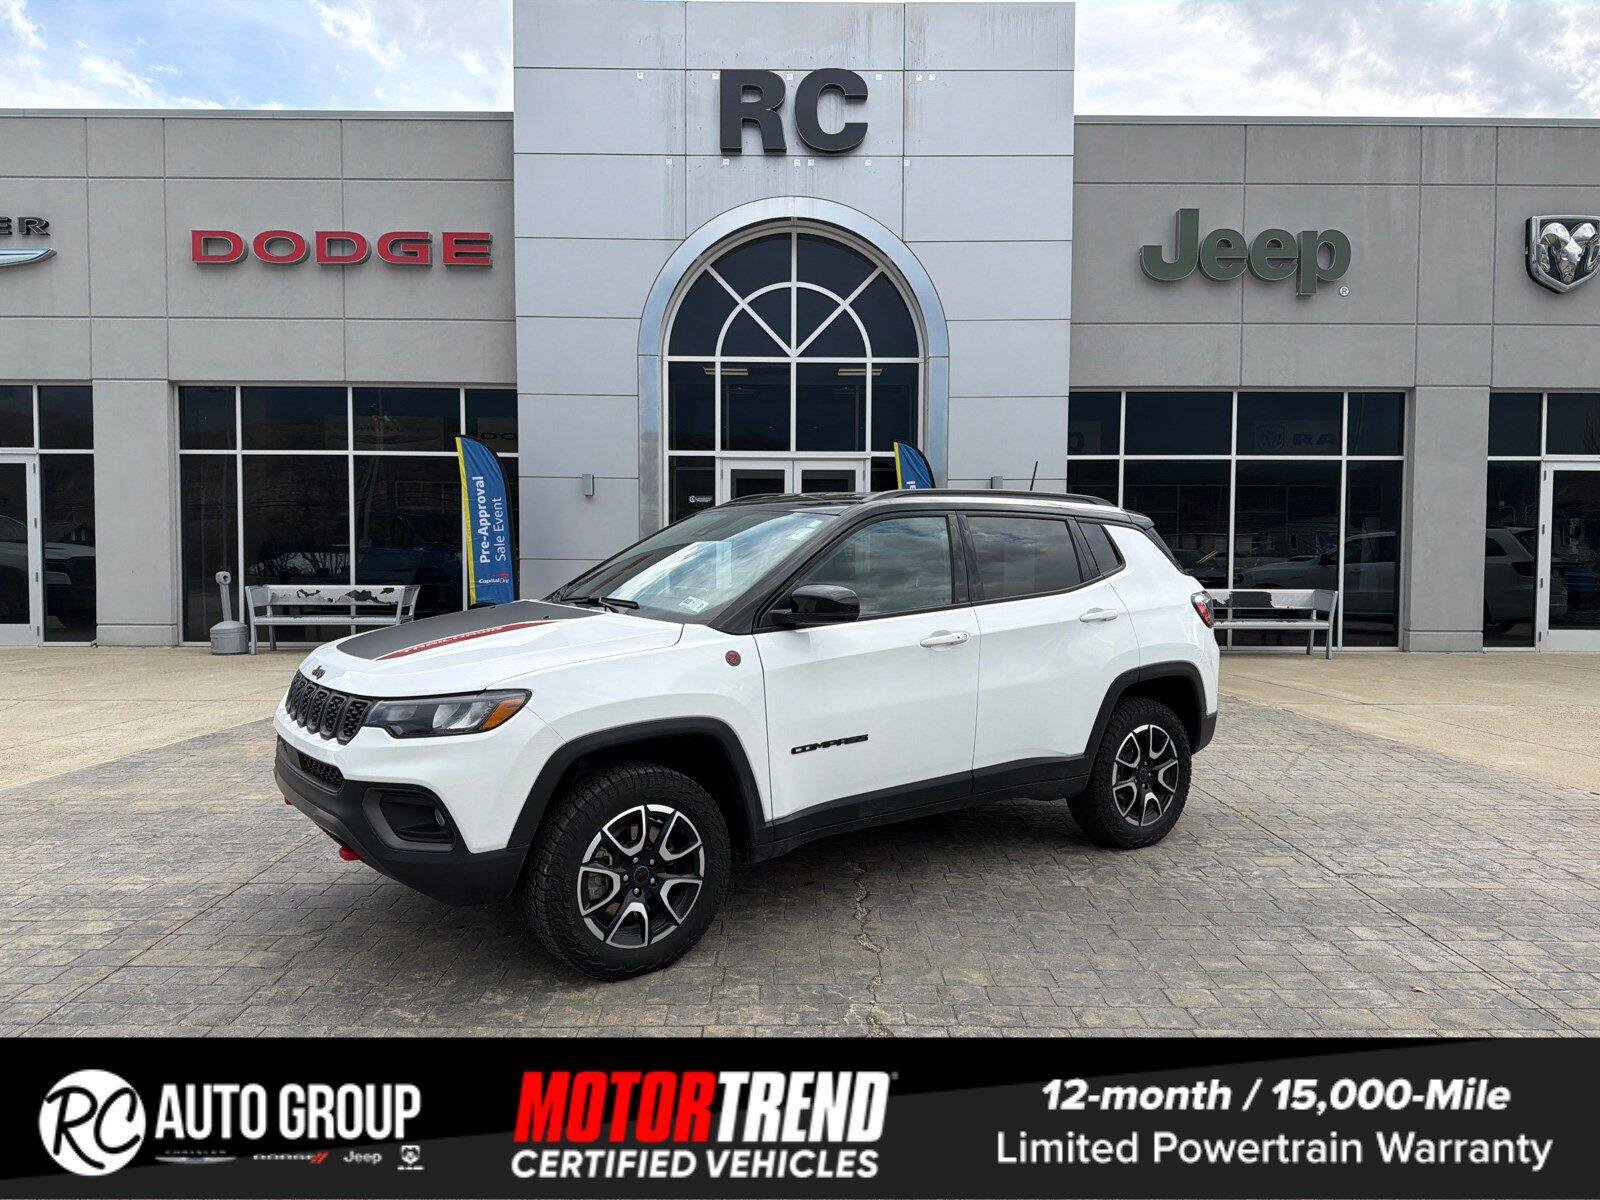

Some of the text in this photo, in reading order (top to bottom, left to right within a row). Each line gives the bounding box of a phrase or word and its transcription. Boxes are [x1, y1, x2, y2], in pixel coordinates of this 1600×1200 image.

[720, 68, 868, 154] RC
[191, 229, 493, 268] DODGE
[1139, 208, 1352, 297] Jeep
[472, 475, 491, 564] Pre-Approval
[492, 497, 506, 562] Sale Event
